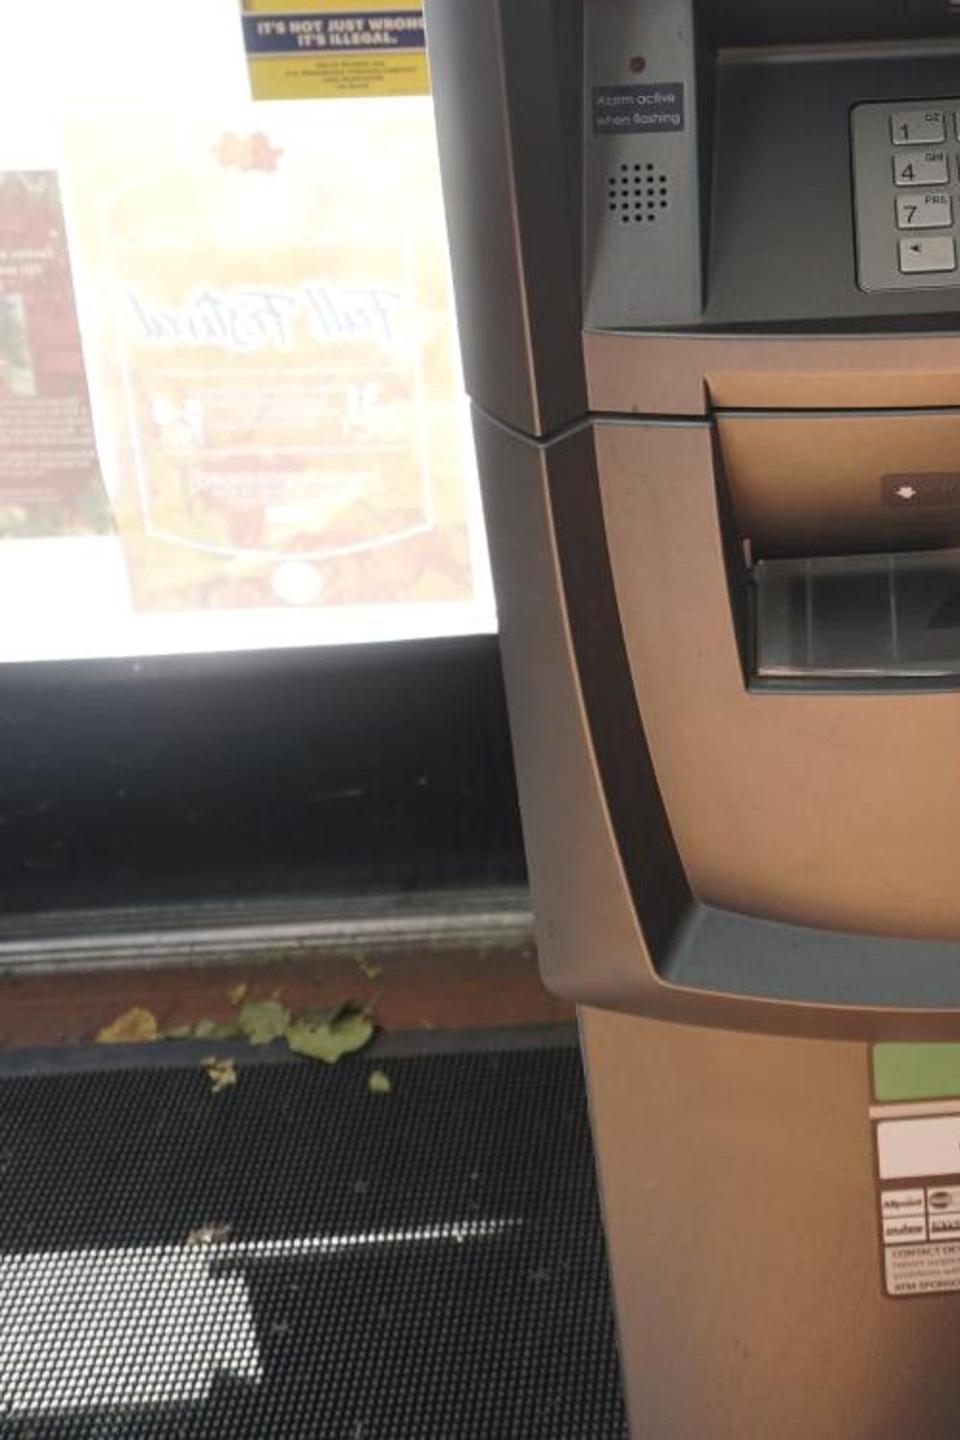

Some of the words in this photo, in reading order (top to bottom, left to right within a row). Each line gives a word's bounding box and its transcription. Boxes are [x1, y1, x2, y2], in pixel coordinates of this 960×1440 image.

[257, 20, 286, 35] IT'S
[289, 20, 323, 33] NOT
[327, 18, 365, 32] JUST
[296, 33, 327, 47] IT'S
[329, 32, 398, 47] ILLEGAL.
[636, 91, 676, 105] active
[633, 112, 681, 127] flashing
[900, 123, 909, 140] 1
[901, 163, 916, 181] 4
[903, 205, 918, 224] 7
